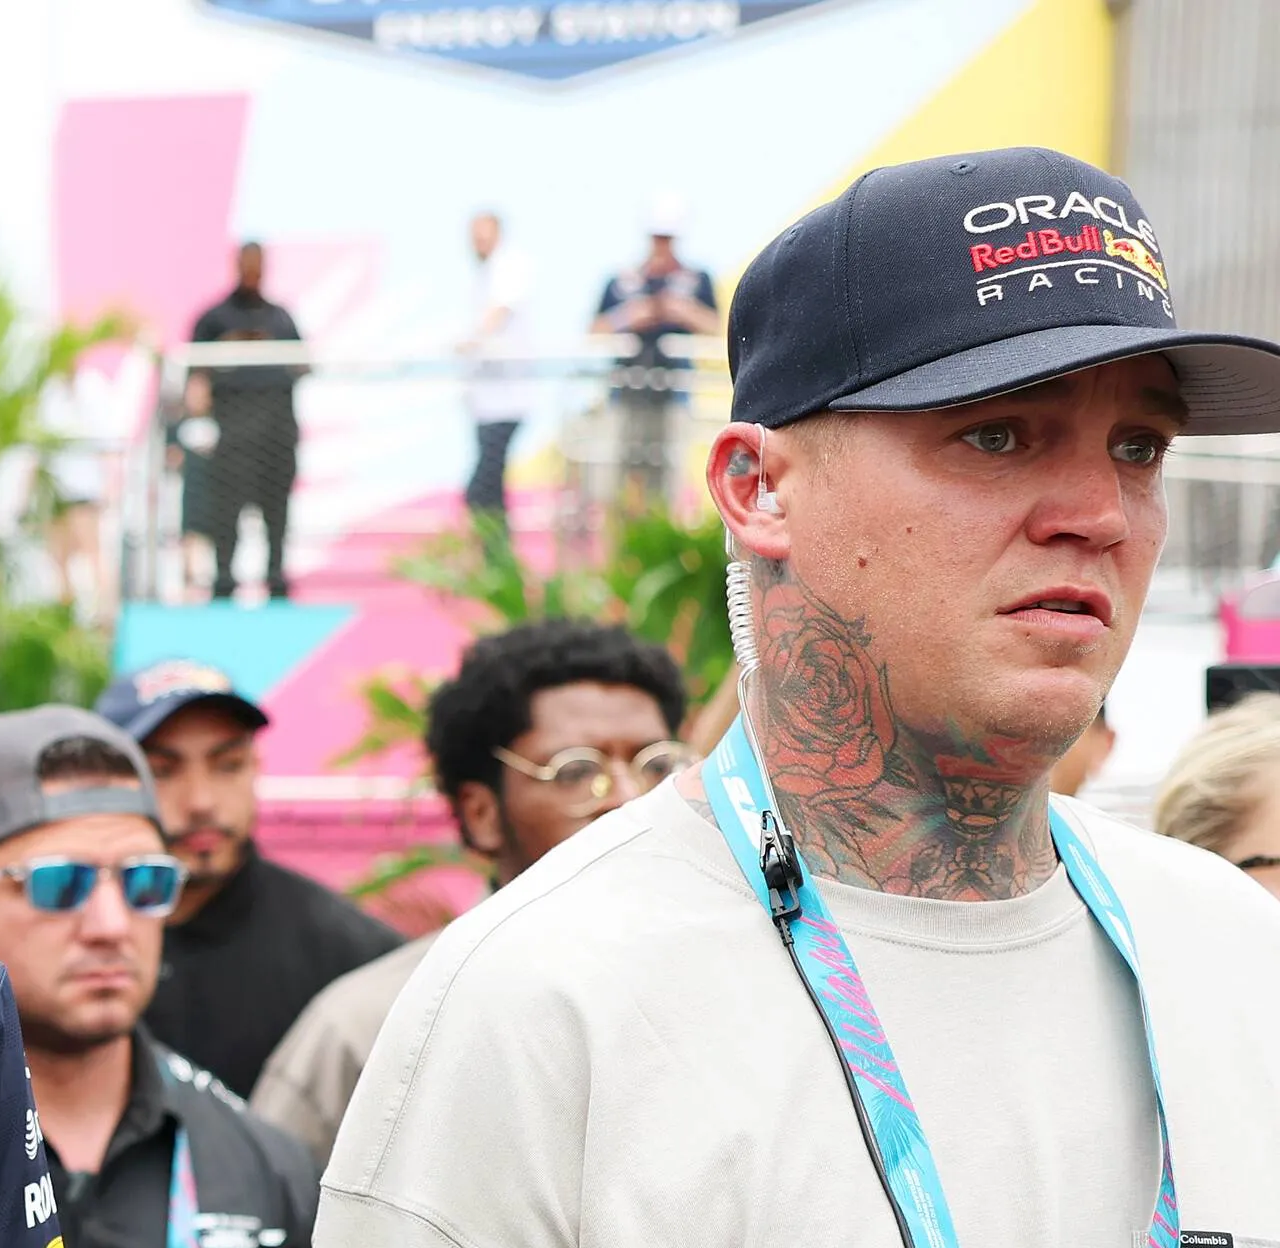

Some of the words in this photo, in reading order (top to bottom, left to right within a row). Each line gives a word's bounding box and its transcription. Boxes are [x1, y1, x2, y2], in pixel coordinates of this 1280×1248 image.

[963, 191, 1159, 253] ORACLE
[976, 267, 1173, 318] RACING
[1180, 1235, 1228, 1246] Columbia
